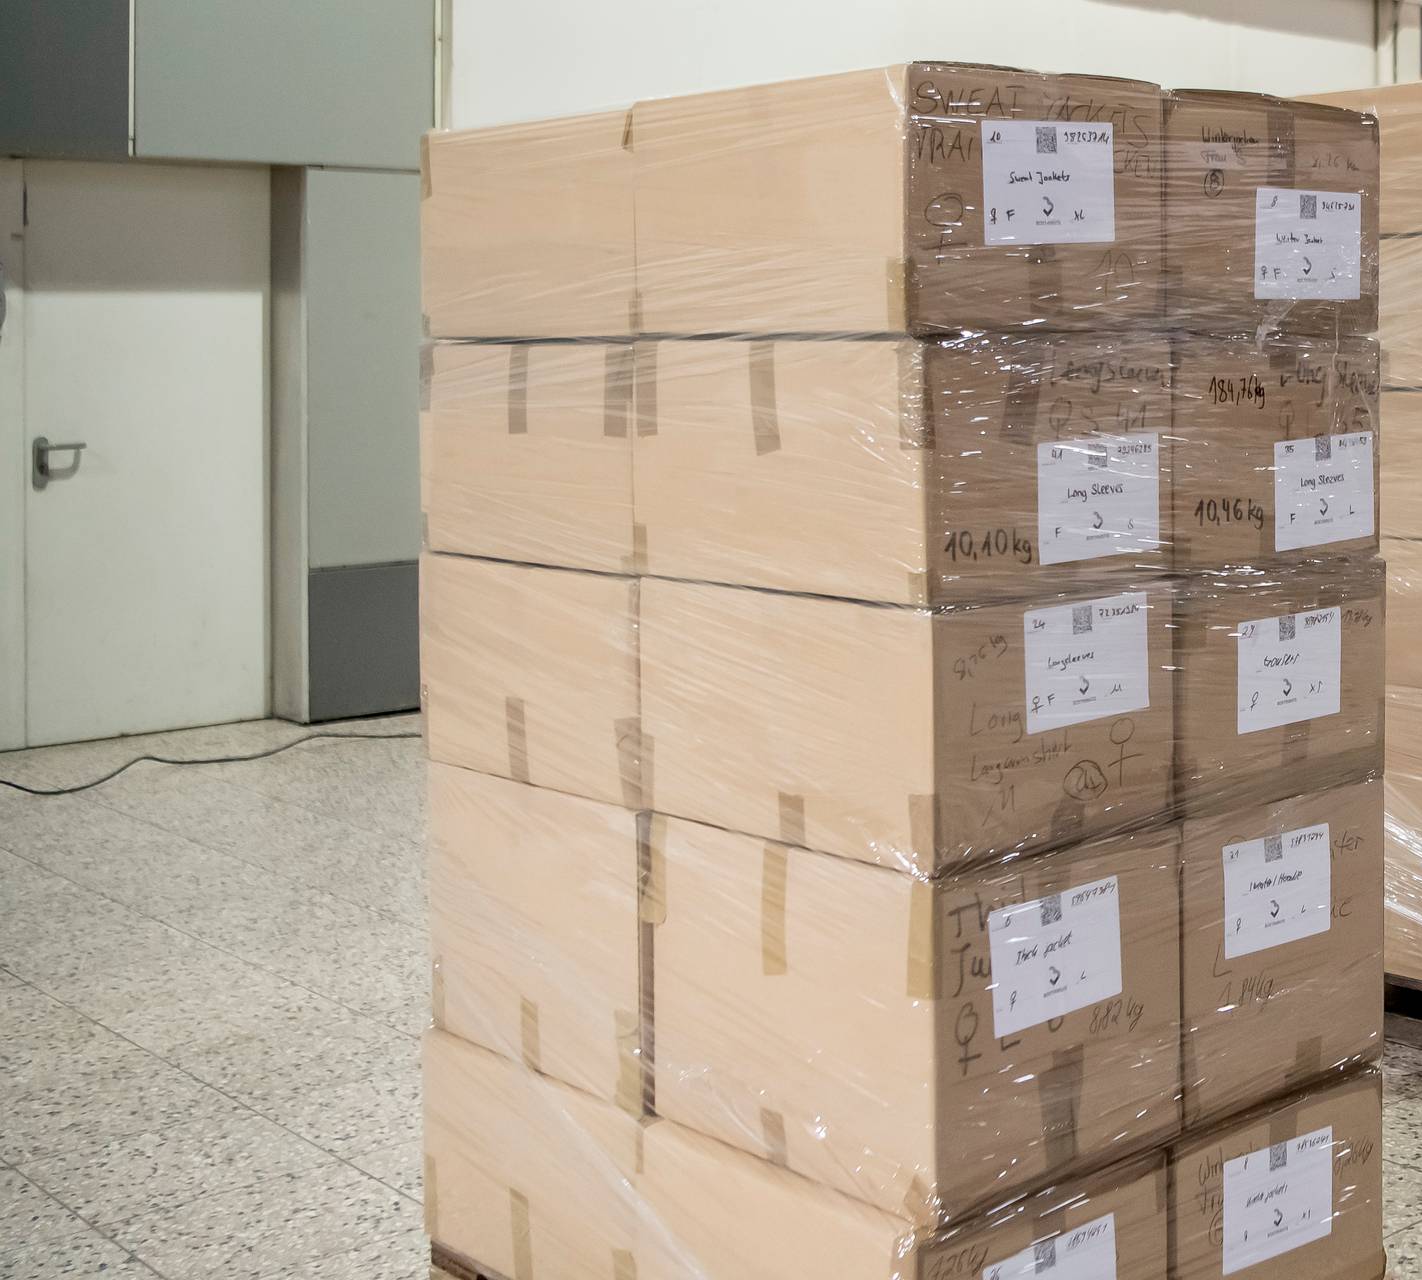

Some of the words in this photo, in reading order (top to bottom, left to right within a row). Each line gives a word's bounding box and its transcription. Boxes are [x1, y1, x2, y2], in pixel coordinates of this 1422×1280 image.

[910, 80, 1025, 118] SWEAT
[1006, 209, 1015, 221] F
[1273, 267, 1281, 281] F
[1300, 478, 1317, 491] Long
[1067, 487, 1088, 503] Long
[1091, 482, 1125, 496] Sleeves
[1290, 512, 1297, 525] F
[1349, 504, 1355, 516] L
[1055, 526, 1062, 538] F
[1047, 693, 1056, 705] F
[969, 702, 1024, 744] Long
